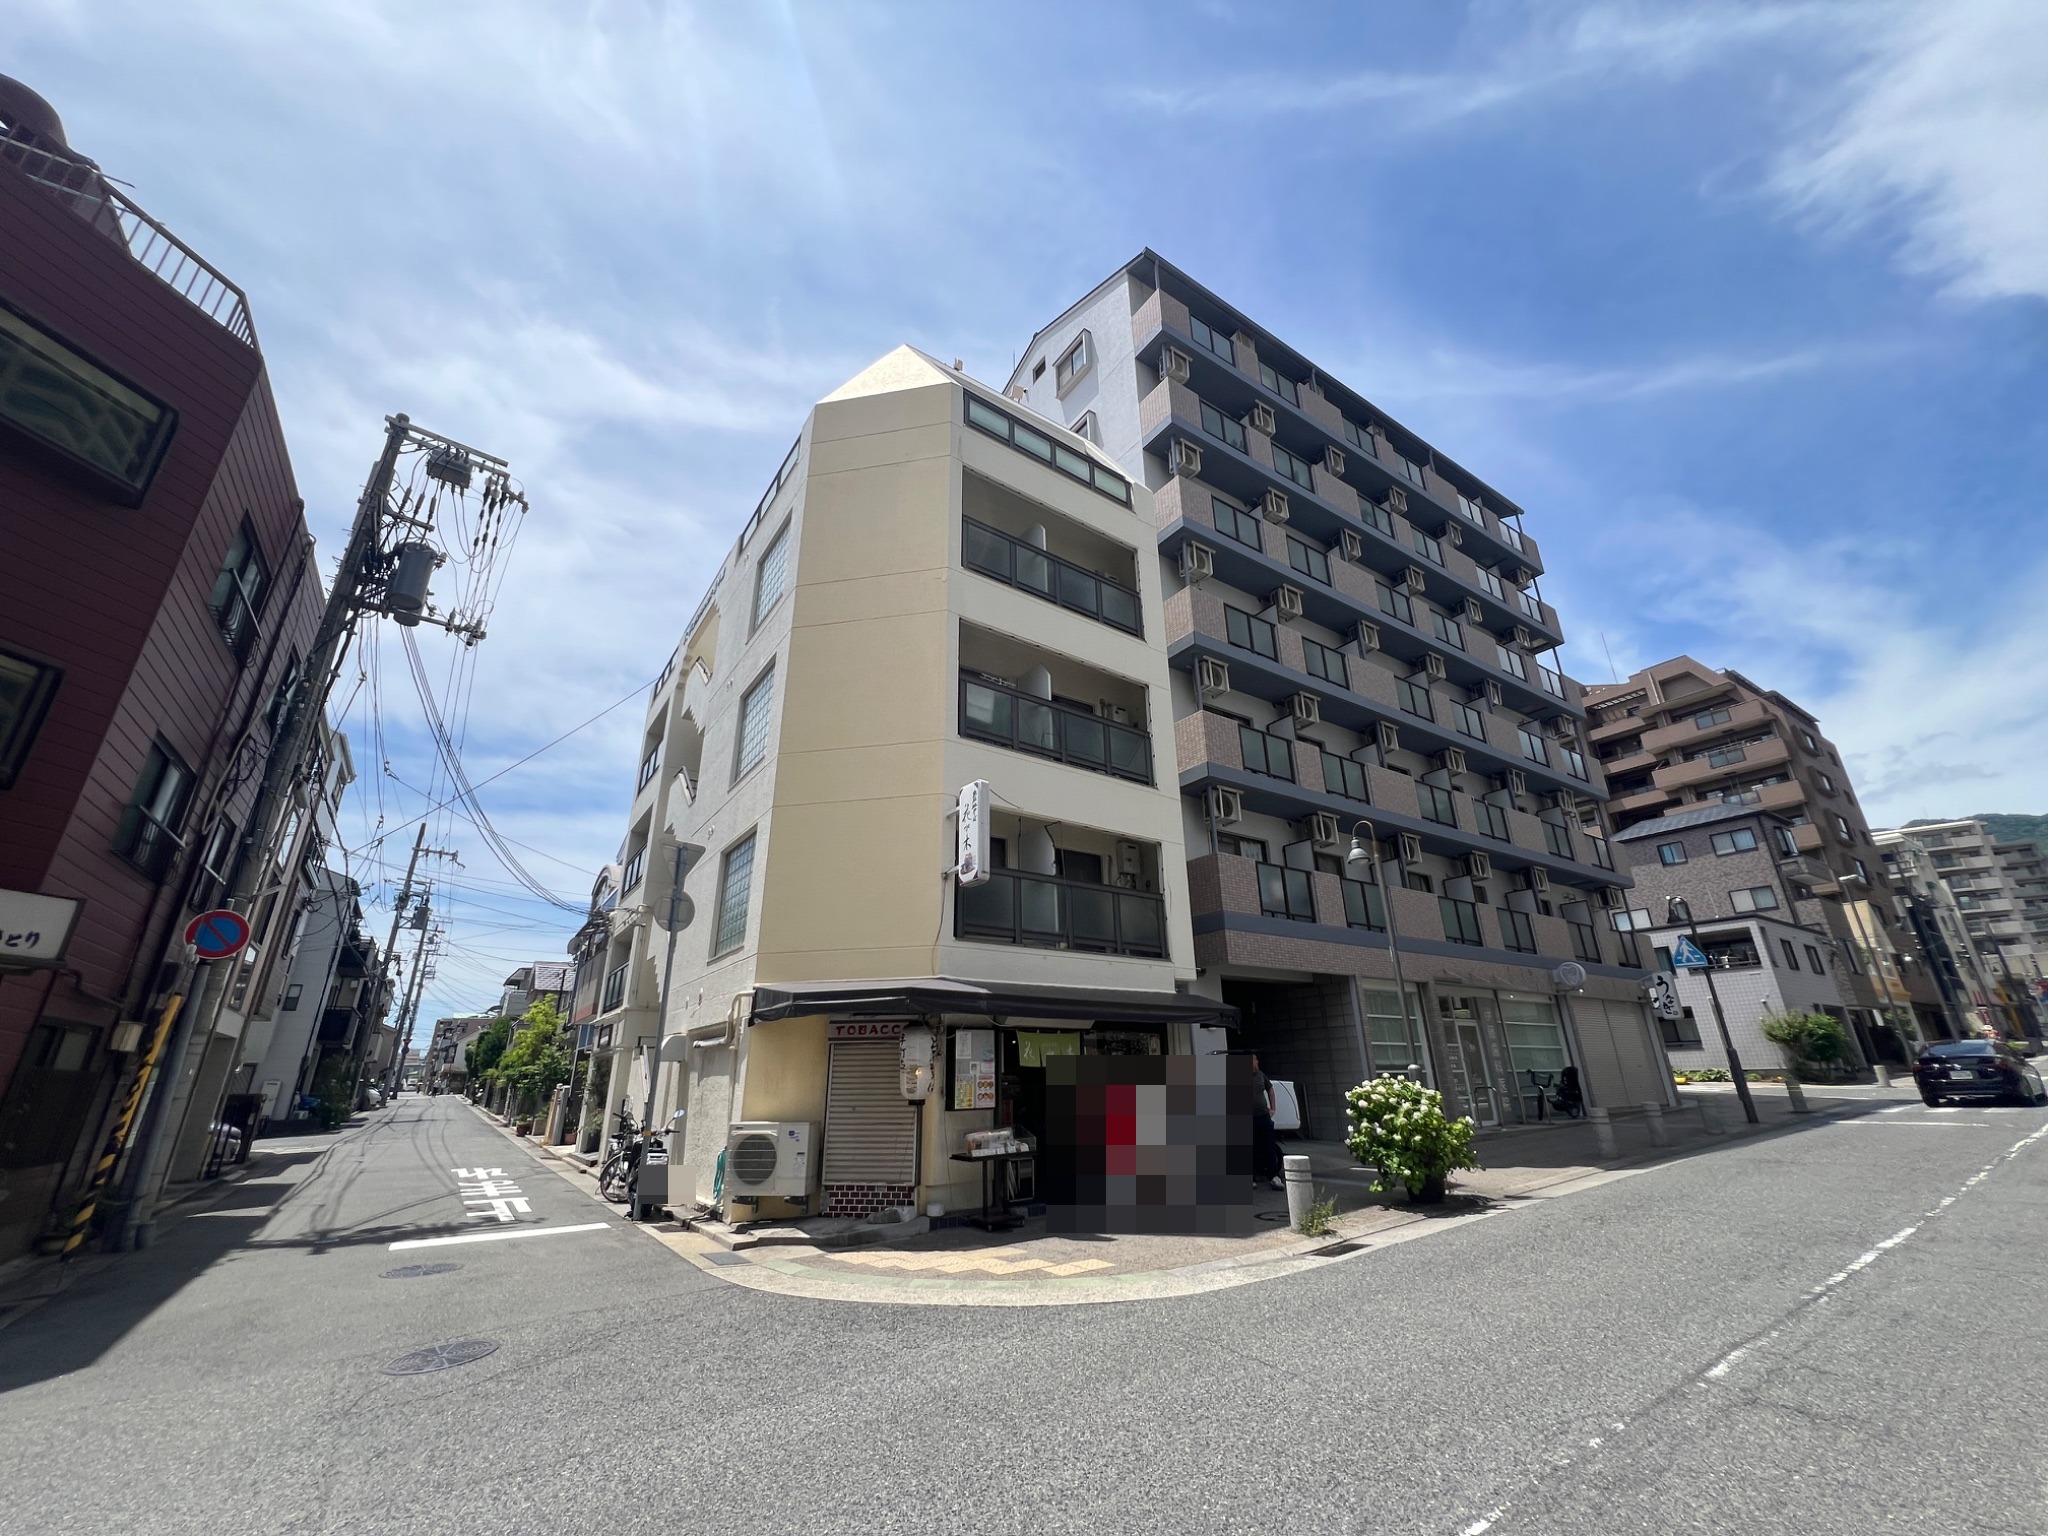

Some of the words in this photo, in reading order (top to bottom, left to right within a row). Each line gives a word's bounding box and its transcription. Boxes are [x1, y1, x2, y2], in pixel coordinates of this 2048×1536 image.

[0, 929, 40, 949] とり
[1656, 975, 1675, 1014] うなぎ
[451, 1167, 532, 1222] 止まれ
